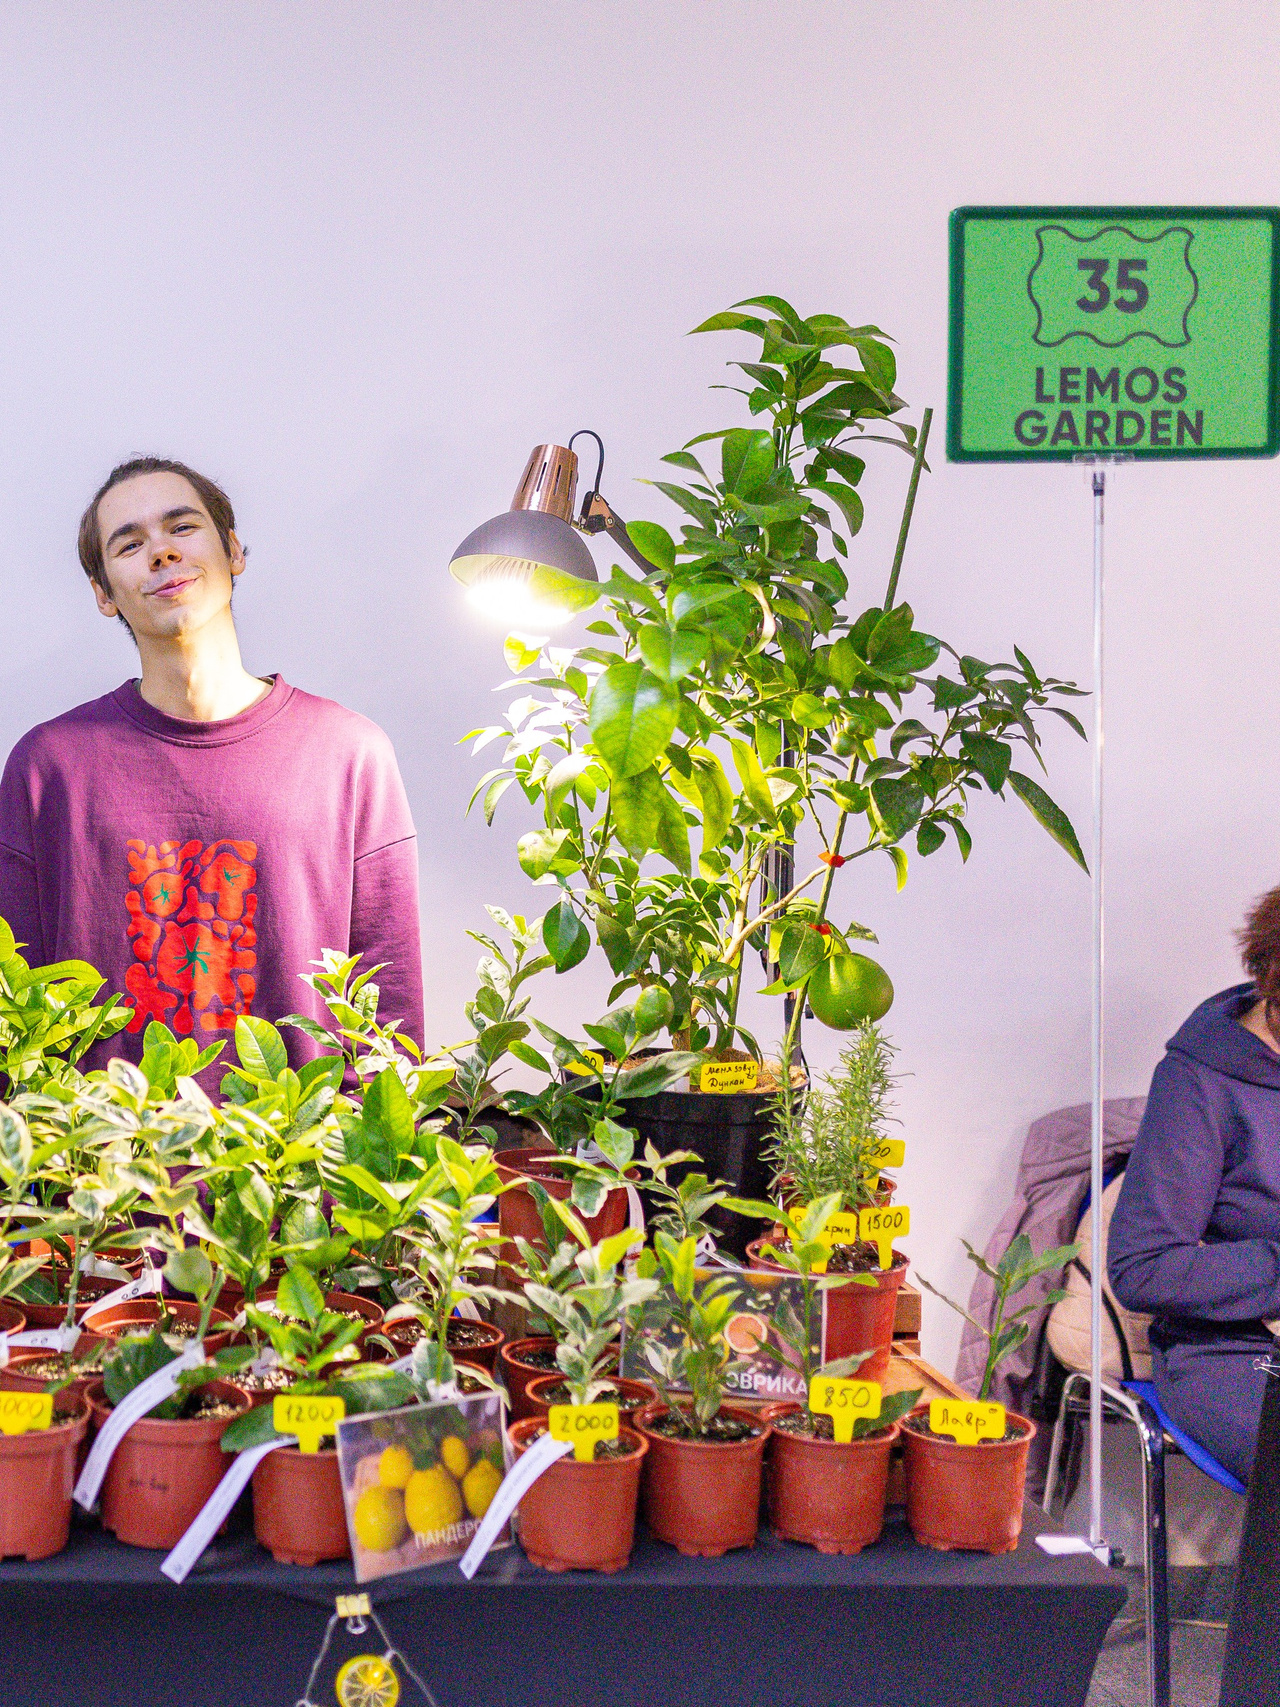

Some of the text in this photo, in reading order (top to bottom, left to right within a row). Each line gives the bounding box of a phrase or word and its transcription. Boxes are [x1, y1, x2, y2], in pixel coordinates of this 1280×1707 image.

[1076, 258, 1149, 313] 35
[1035, 366, 1187, 404] LEMOS
[1014, 410, 1203, 447] GARDEN
[867, 1212, 903, 1232] 1500
[824, 1386, 871, 1408] 850
[286, 1404, 335, 1422] 1200
[560, 1414, 614, 1433] 2000
[939, 1408, 987, 1435] Лавр
